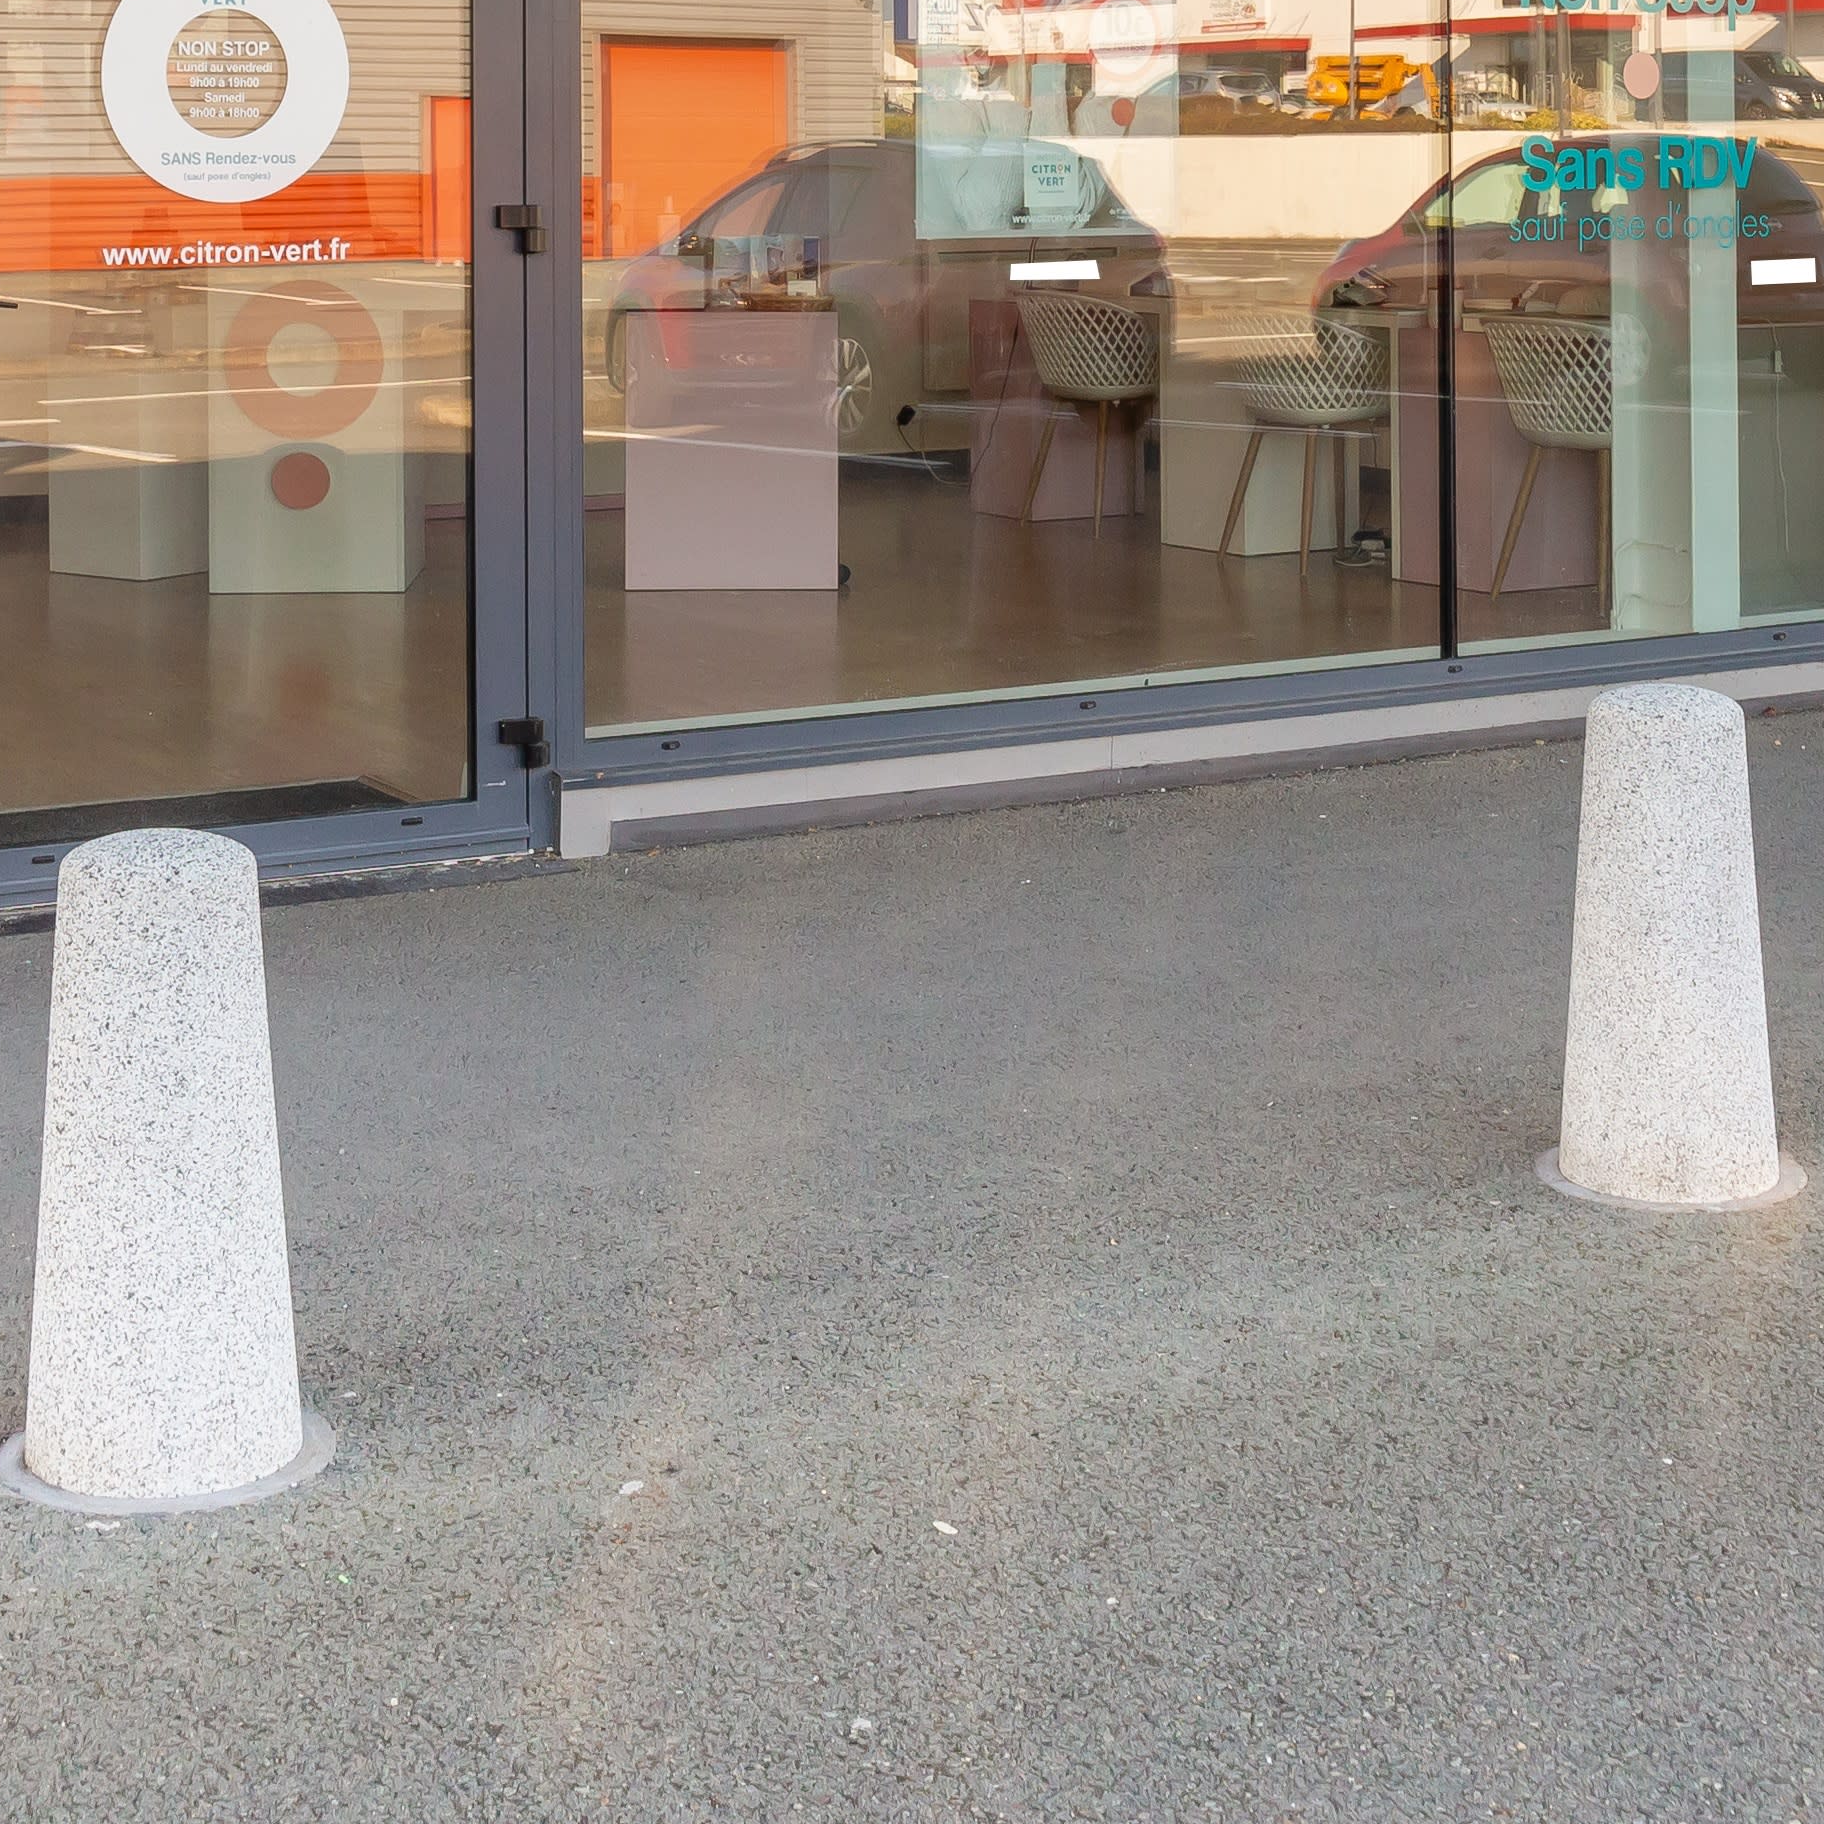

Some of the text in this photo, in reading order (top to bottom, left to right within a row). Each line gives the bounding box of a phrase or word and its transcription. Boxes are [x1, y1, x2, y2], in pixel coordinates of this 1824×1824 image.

[178, 40, 270, 57] NON STOP
[176, 62, 273, 73] Lundi au vendredi
[189, 77, 216, 88] 9h00
[228, 77, 260, 88] 19h00
[204, 91, 245, 103] Samedi
[189, 107, 216, 118] 9h00
[228, 107, 260, 118] 18h00
[161, 152, 297, 166] SANS Rendez-vous
[1520, 134, 1758, 192] Sans RDV
[1031, 163, 1071, 174] CITRON
[207, 174, 229, 182] pose
[1038, 176, 1065, 187] VERT
[1509, 200, 1771, 253] sauf pose d'ongles
[102, 237, 351, 266] www.citron-vert.fr
